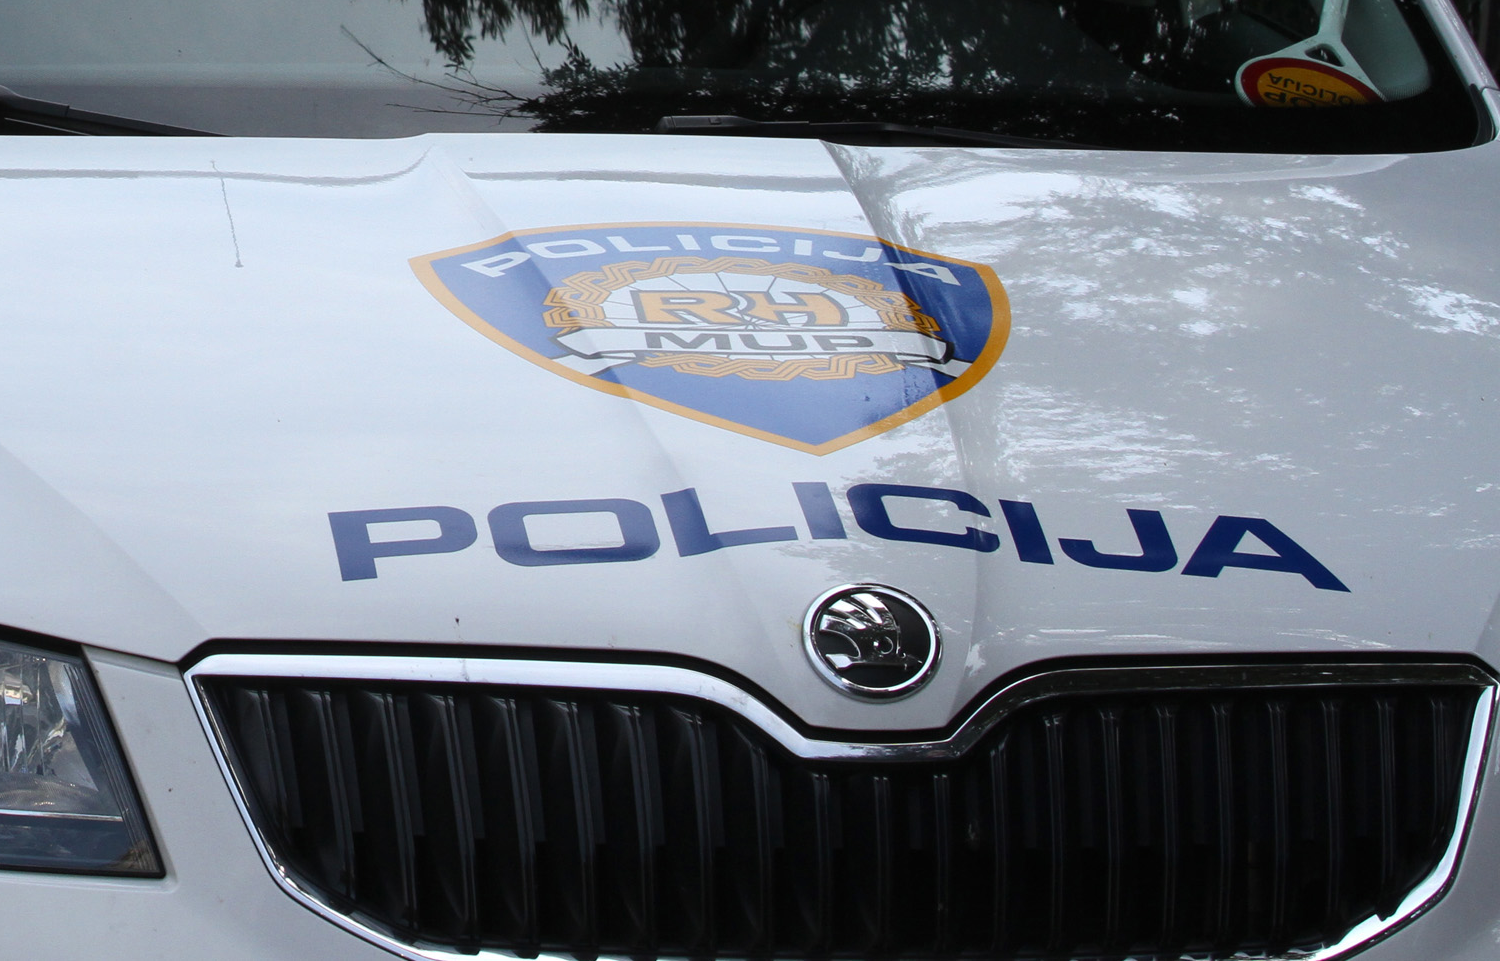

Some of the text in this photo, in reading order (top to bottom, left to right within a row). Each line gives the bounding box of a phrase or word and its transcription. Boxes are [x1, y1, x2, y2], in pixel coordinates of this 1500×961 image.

[1268, 72, 1354, 105] OLICIJA
[461, 235, 961, 286] POLICIJA
[629, 290, 847, 326] RH
[645, 331, 873, 352] MUP
[329, 482, 1351, 594] POLICIJA
